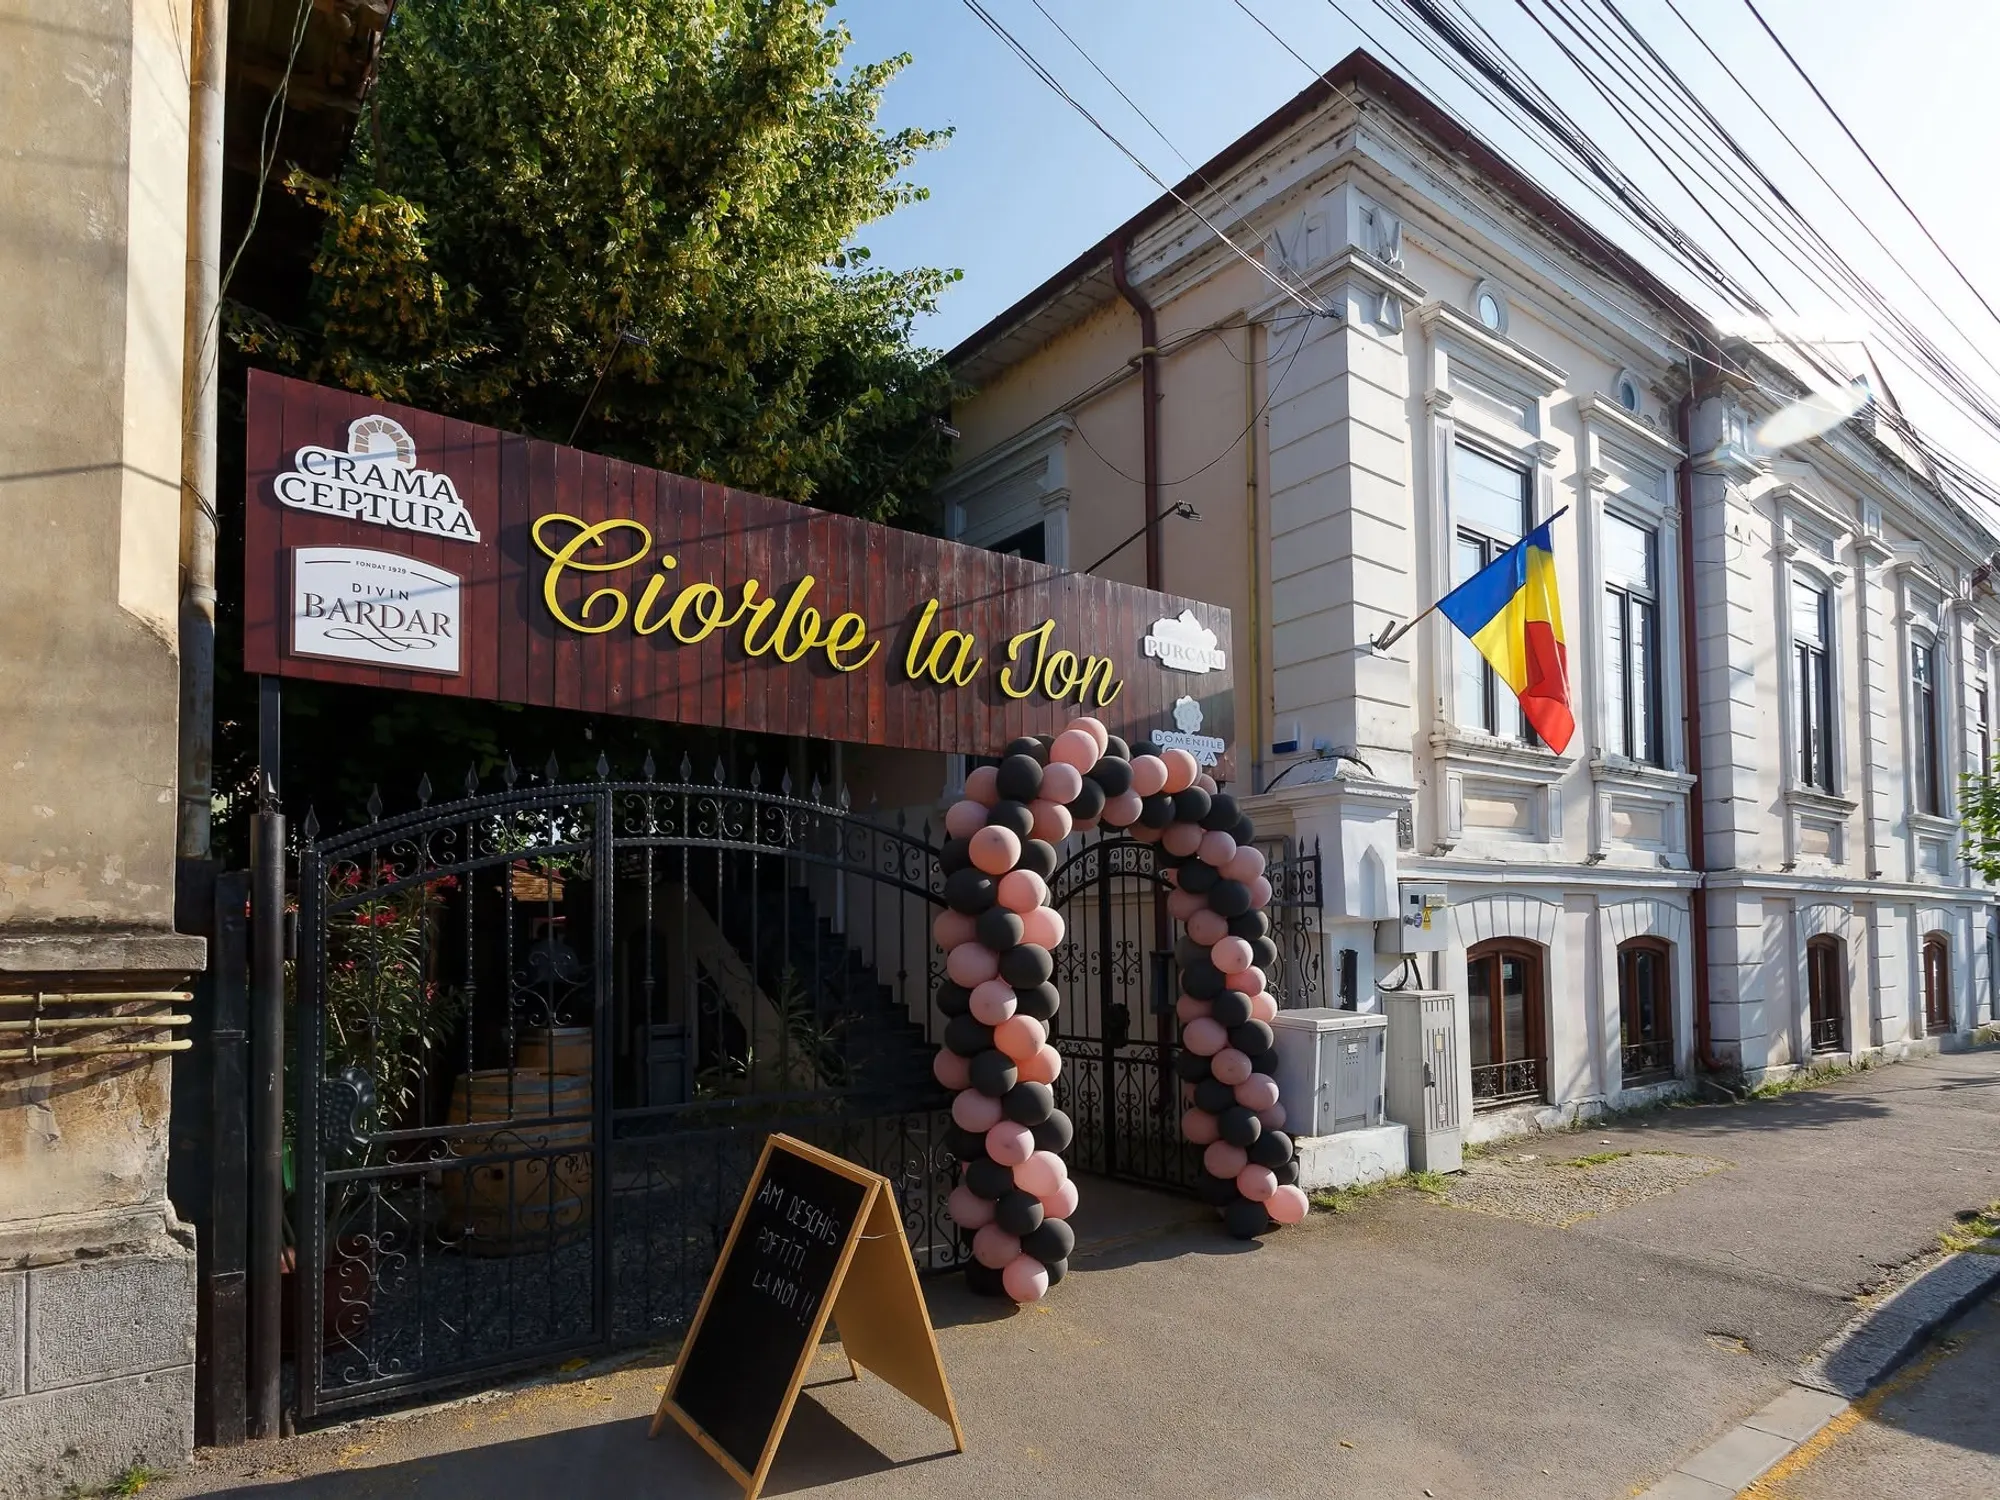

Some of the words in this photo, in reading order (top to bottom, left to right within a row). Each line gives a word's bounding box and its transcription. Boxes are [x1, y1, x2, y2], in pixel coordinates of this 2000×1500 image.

[301, 450, 459, 505] CRAMA
[280, 476, 476, 537] CEPTURA
[355, 560, 386, 570] FONDAT
[351, 582, 409, 601] DIVIN
[531, 513, 881, 672] Ciorbe
[905, 598, 984, 687] la
[302, 592, 453, 652] BARDAR
[1156, 733, 1223, 749] DOMENIILE
[1166, 747, 1215, 763] ZA
[758, 1179, 784, 1210] AM
[786, 1195, 840, 1246] DESCHIS
[752, 1269, 771, 1294] LA
[772, 1275, 803, 1309] NOI
